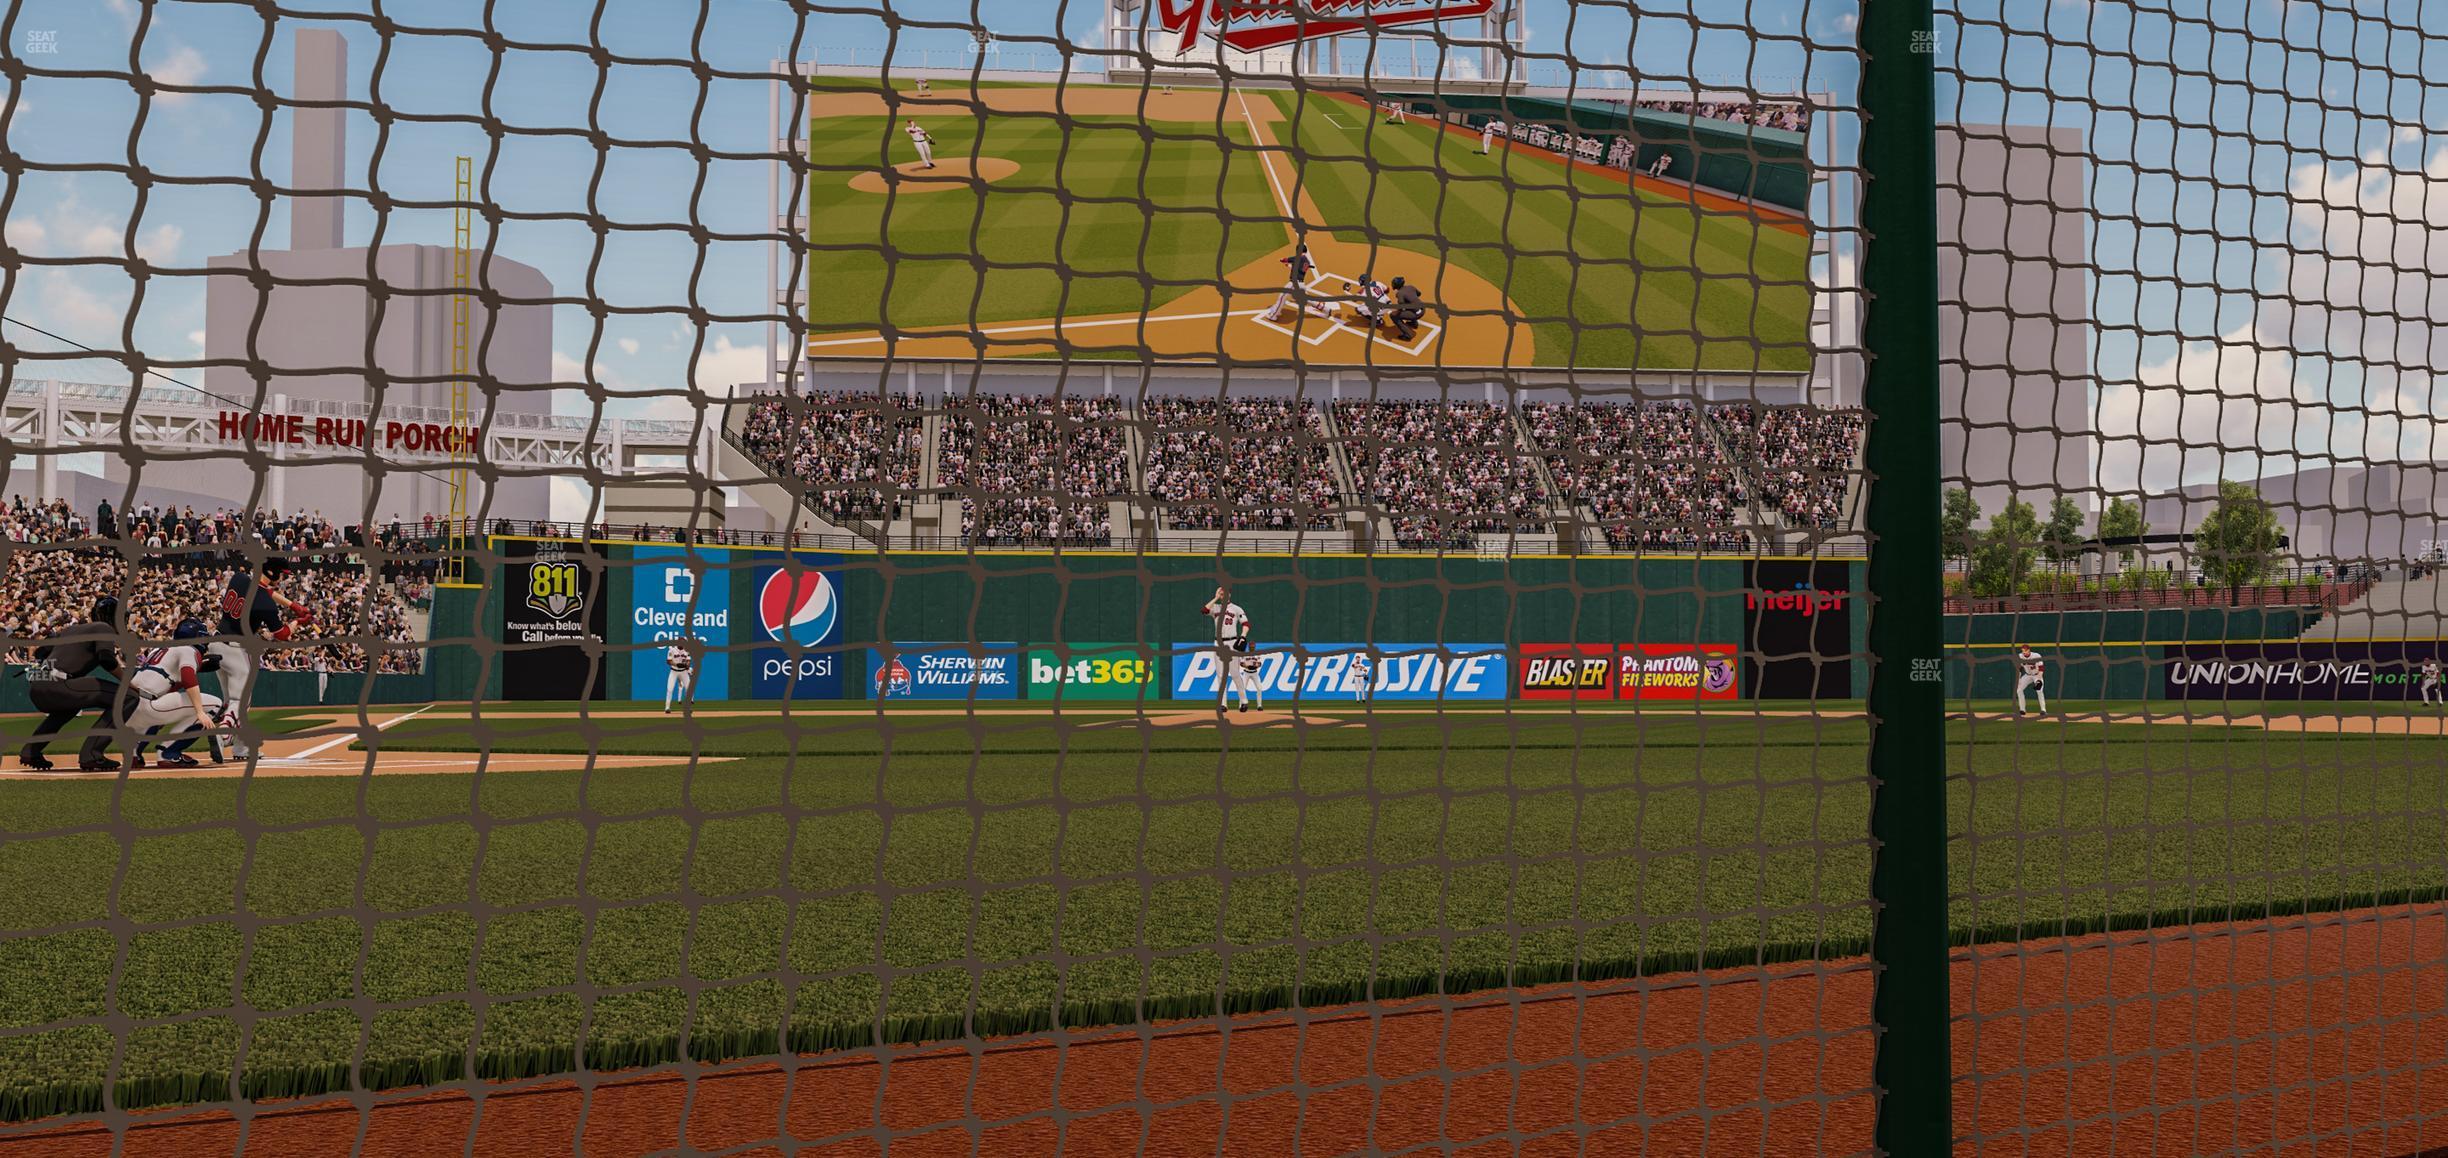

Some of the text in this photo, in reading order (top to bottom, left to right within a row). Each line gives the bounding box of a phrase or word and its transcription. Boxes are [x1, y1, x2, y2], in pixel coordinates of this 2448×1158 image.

[218, 411, 480, 454] HOME RUN PORCH
[533, 564, 576, 598] 811
[222, 588, 247, 620] 00
[1747, 582, 1846, 617] meijer
[507, 621, 529, 630] Know
[530, 621, 555, 630] what's
[634, 606, 728, 628] Cleveand
[521, 630, 543, 642] Call
[763, 655, 832, 681] pepsi
[918, 655, 1006, 669] SHERWIN
[1031, 658, 1154, 684] bet365
[1525, 658, 1608, 687] BLASER
[2371, 673, 2447, 685] MORTA
